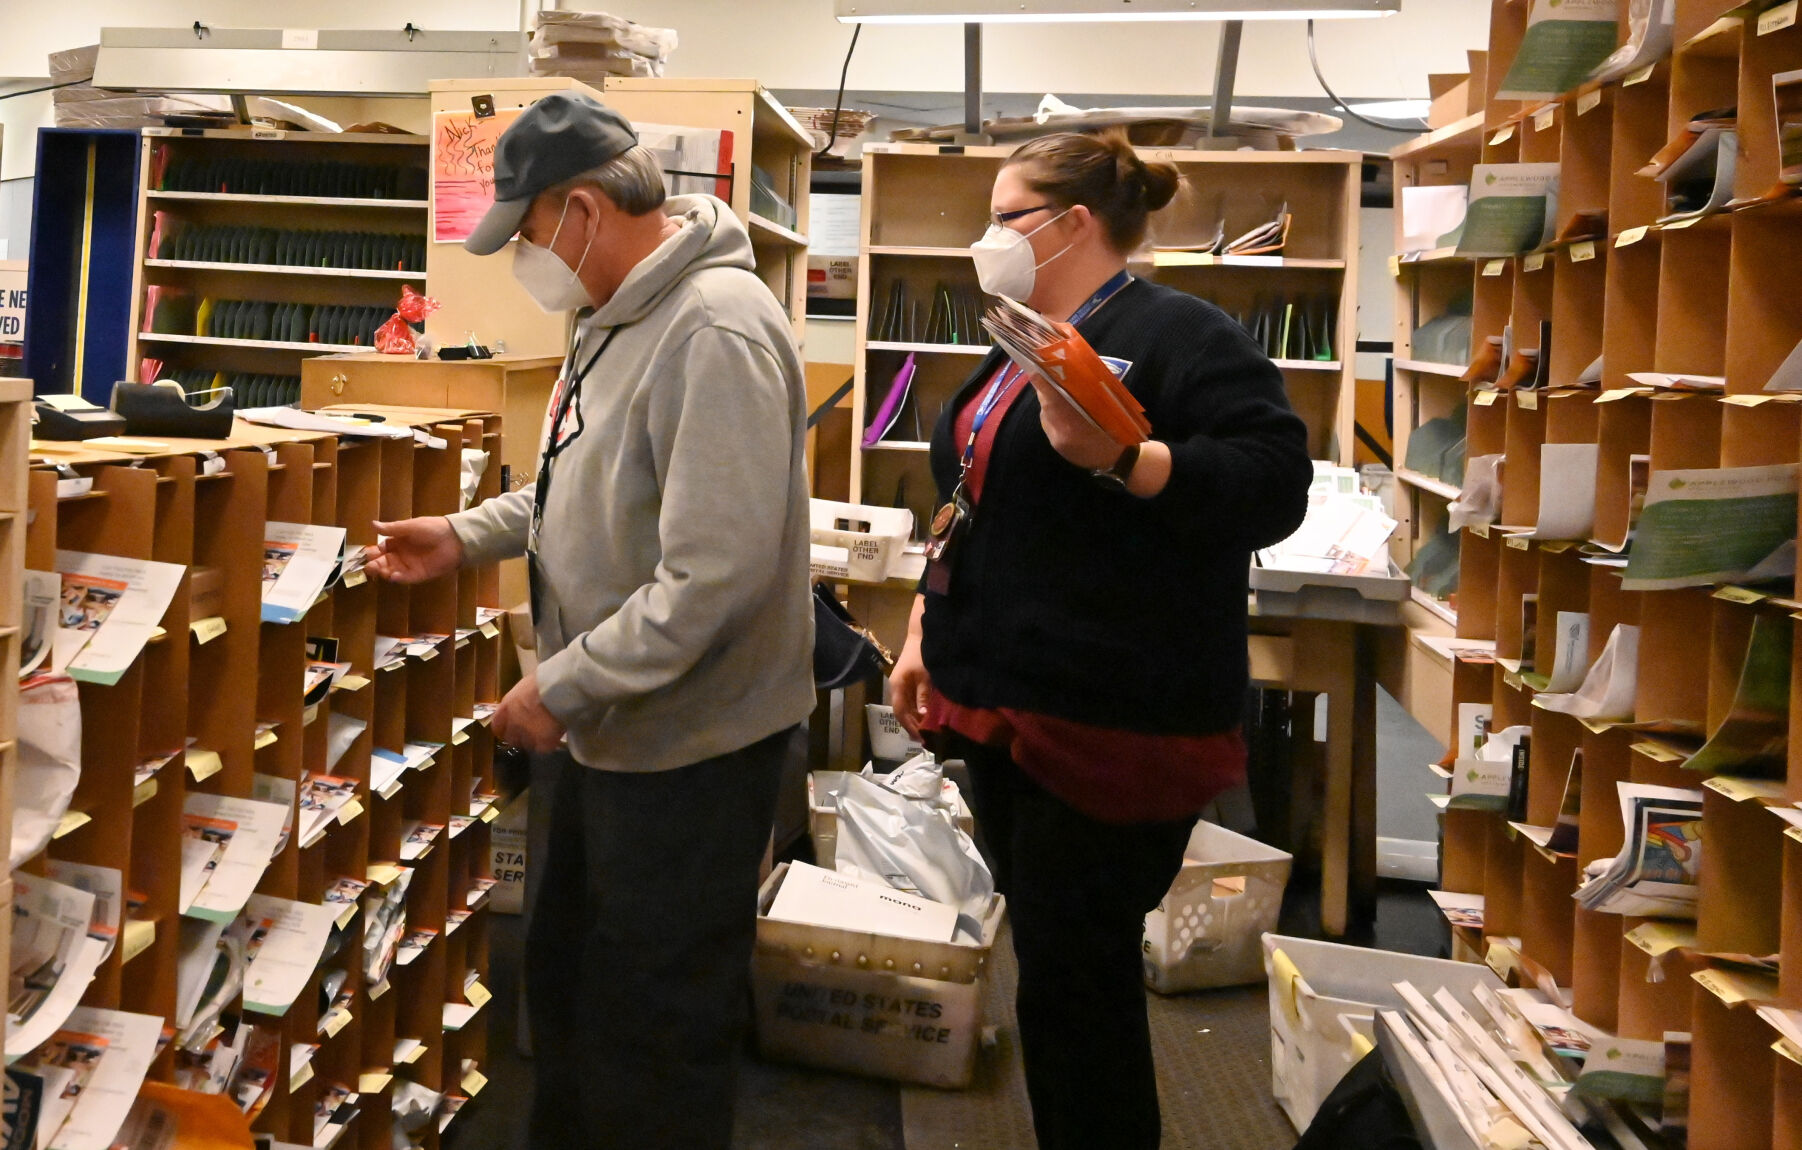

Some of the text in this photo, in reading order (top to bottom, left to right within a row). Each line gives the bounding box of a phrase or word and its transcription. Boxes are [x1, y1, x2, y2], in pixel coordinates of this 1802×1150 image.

[468, 139, 495, 158] Than
[854, 540, 878, 548] LABEL
[853, 546, 879, 554] OTHER
[879, 719, 900, 727] OTHE
[884, 726, 900, 734] END
